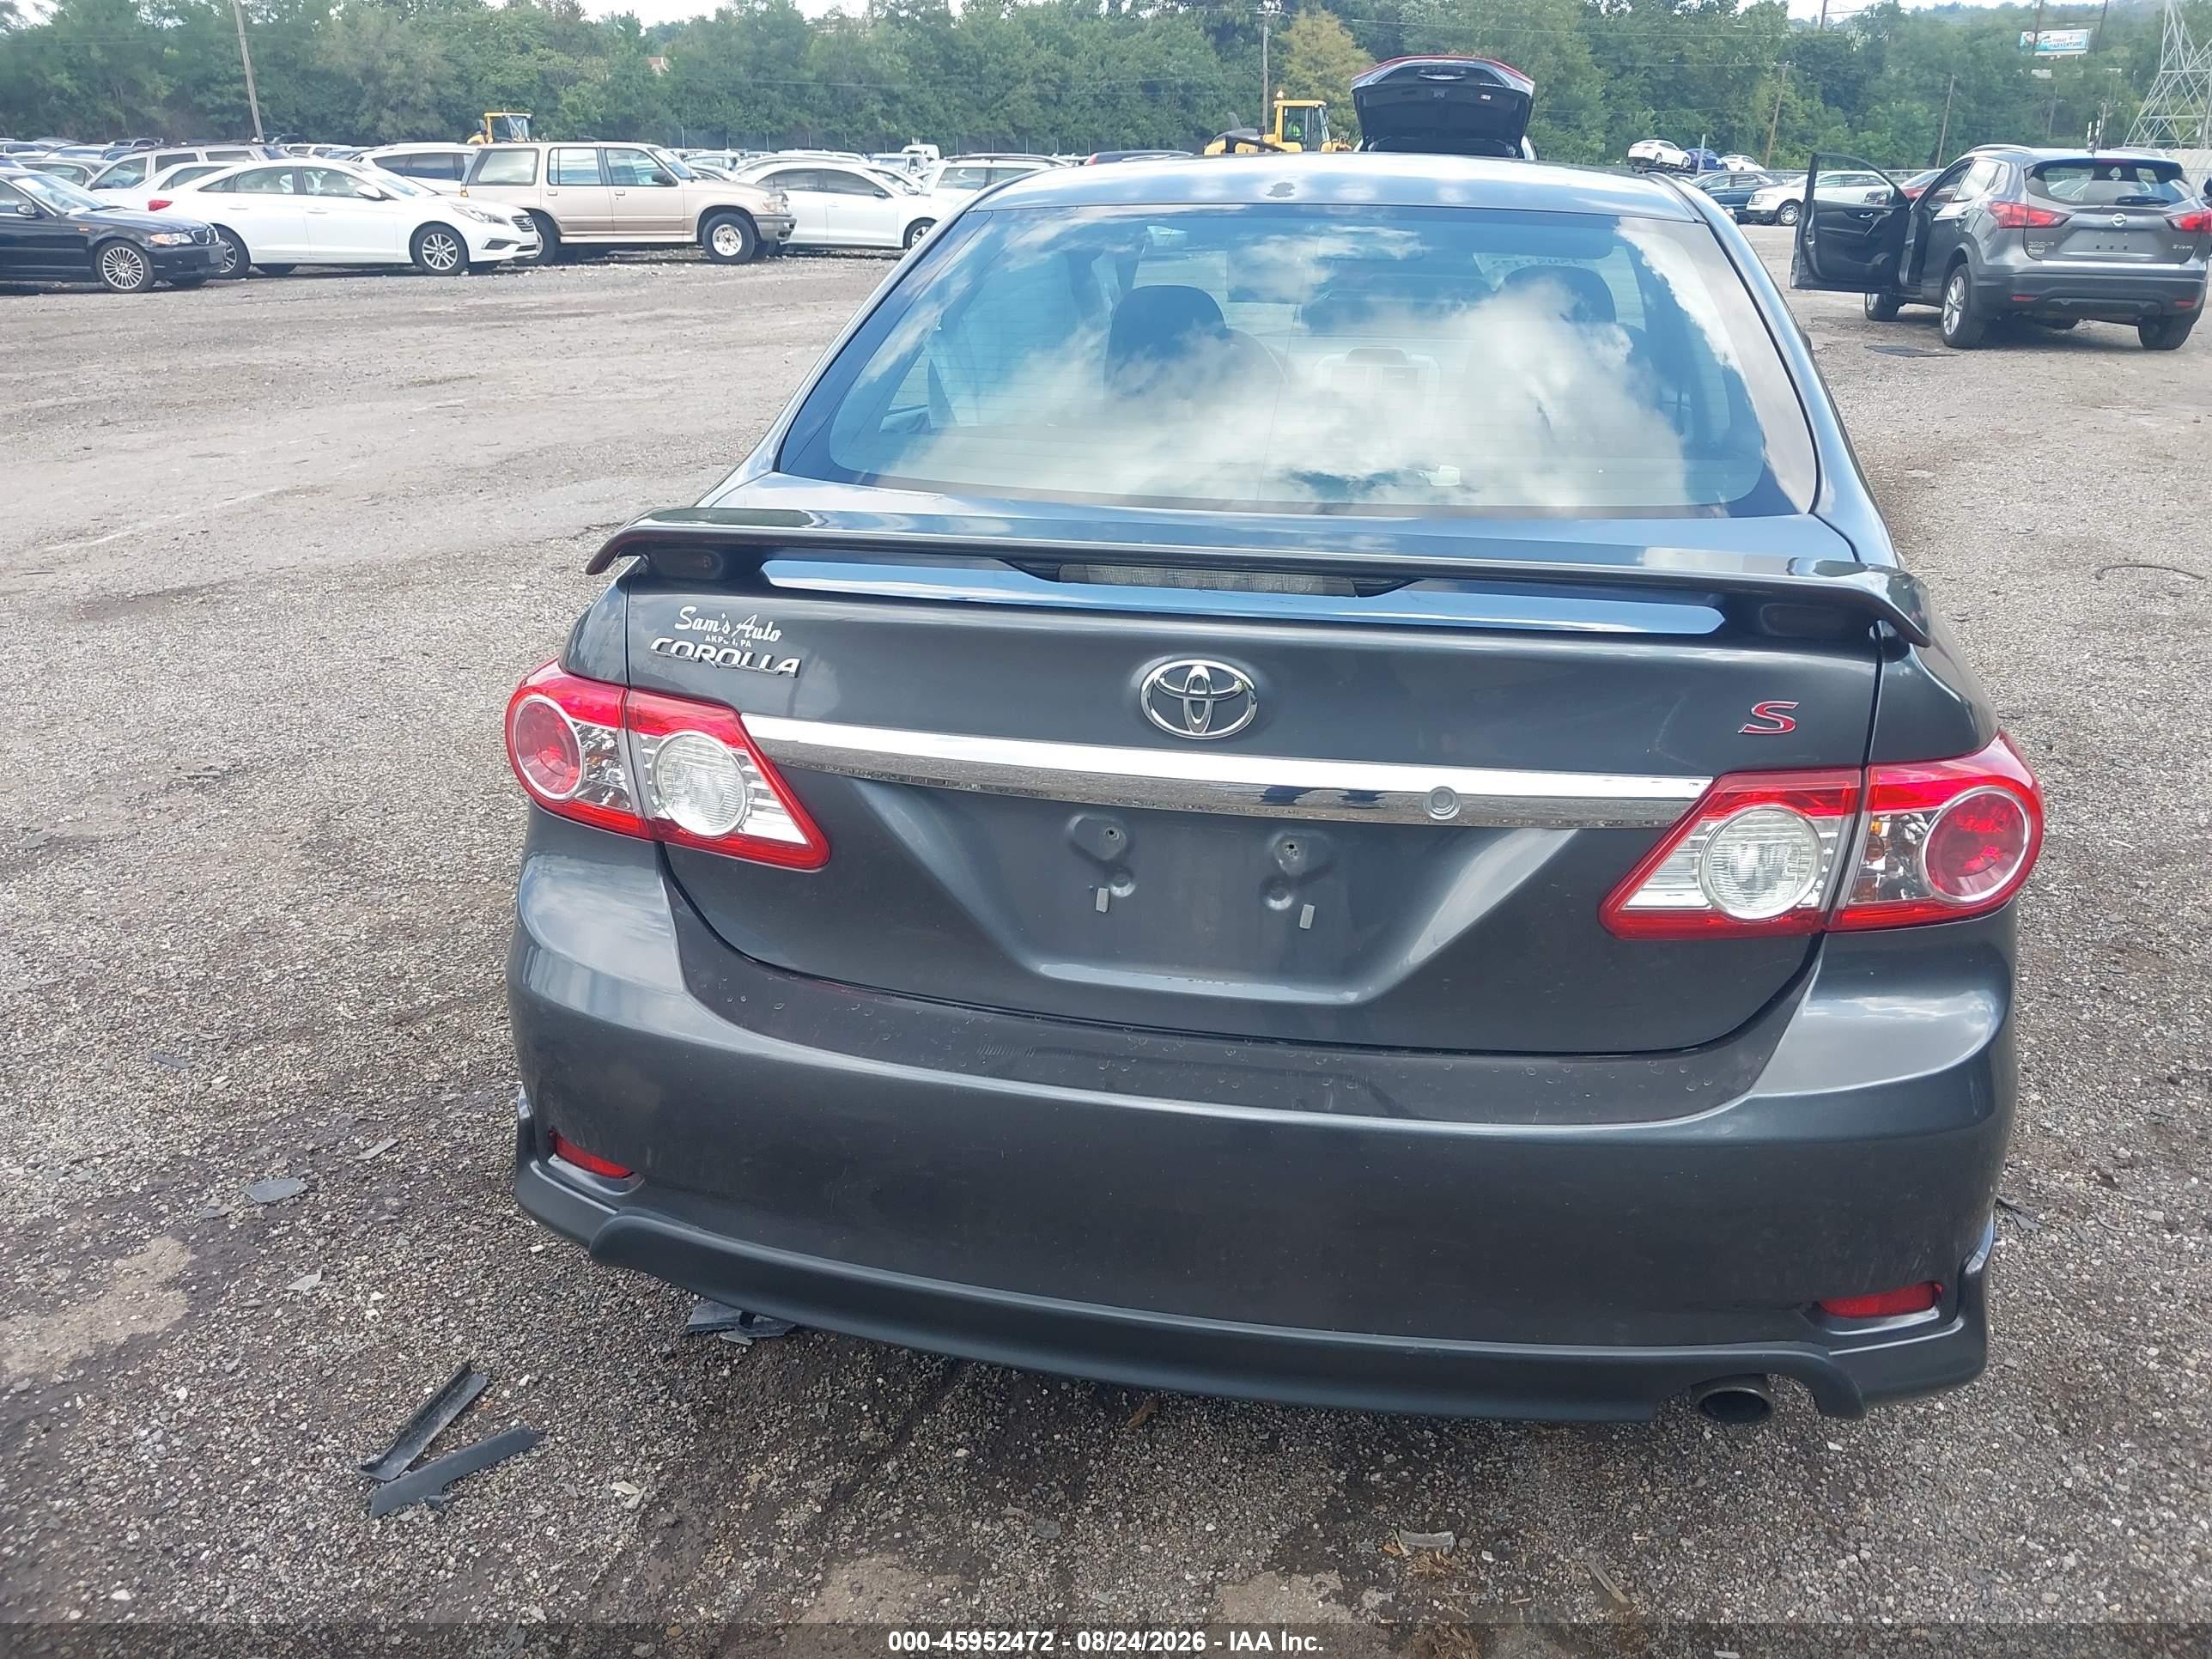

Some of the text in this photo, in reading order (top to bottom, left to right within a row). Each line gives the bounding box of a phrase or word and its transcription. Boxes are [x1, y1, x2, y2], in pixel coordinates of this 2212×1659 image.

[674, 605, 782, 642] Sam's Auto
[650, 637, 803, 678] COROLLA
[740, 639, 752, 647] PA
[1737, 700, 1800, 735] S
